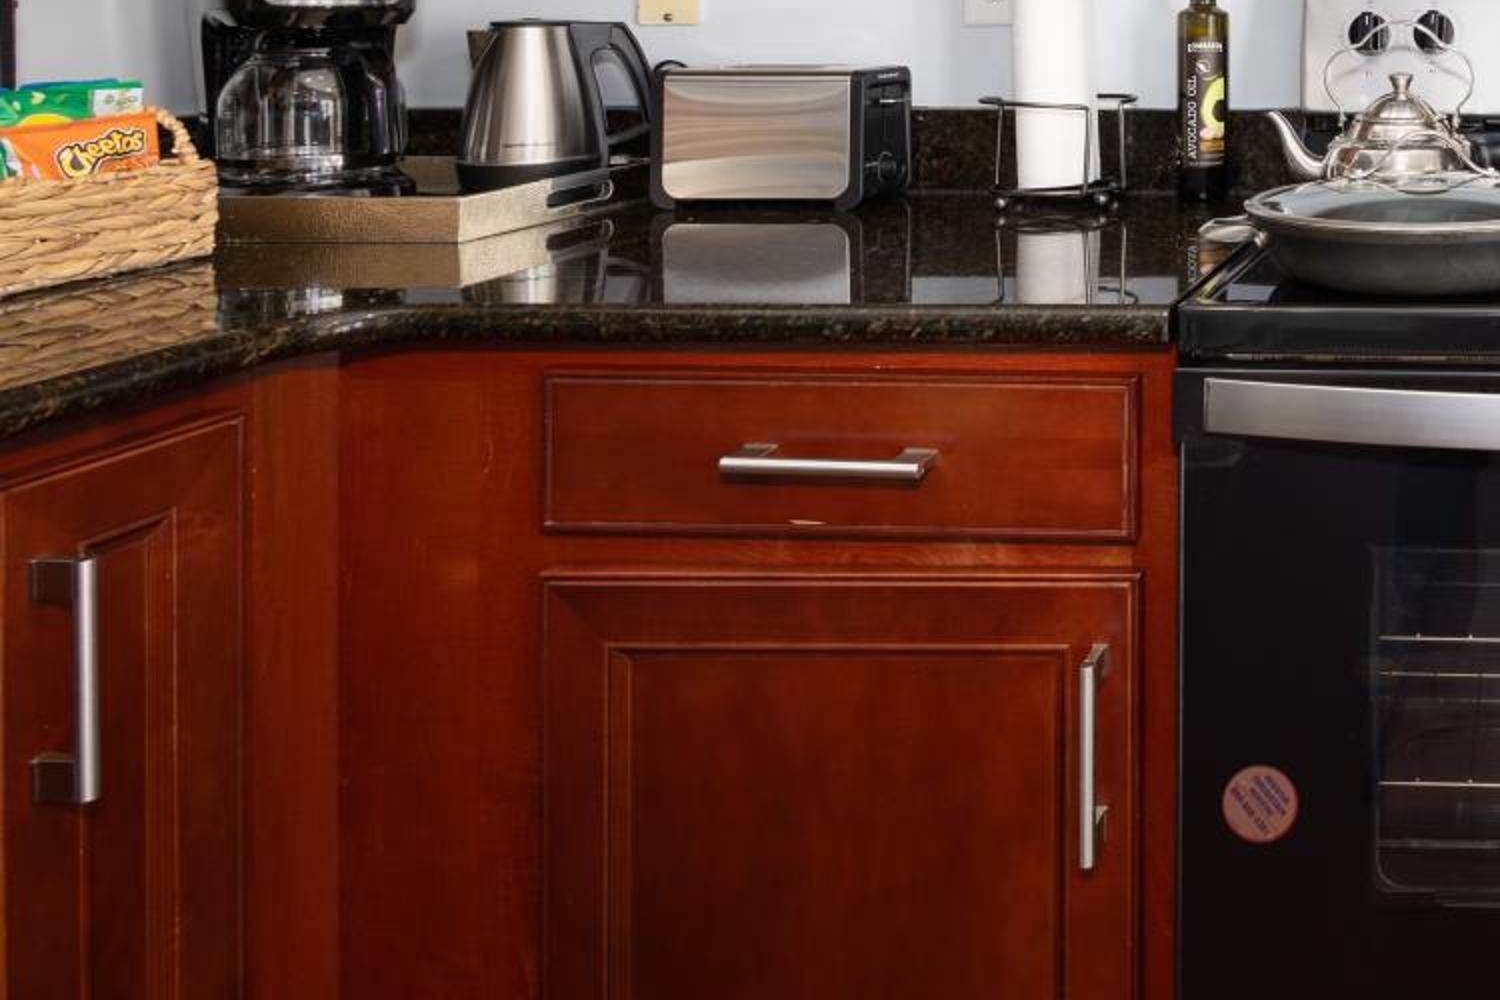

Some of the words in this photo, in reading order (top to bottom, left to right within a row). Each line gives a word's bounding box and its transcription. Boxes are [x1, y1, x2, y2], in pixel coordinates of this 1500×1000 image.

[1188, 76, 1197, 97] OIL
[57, 129, 145, 178] Cheetos
[1188, 102, 1197, 159] AVOCADO
